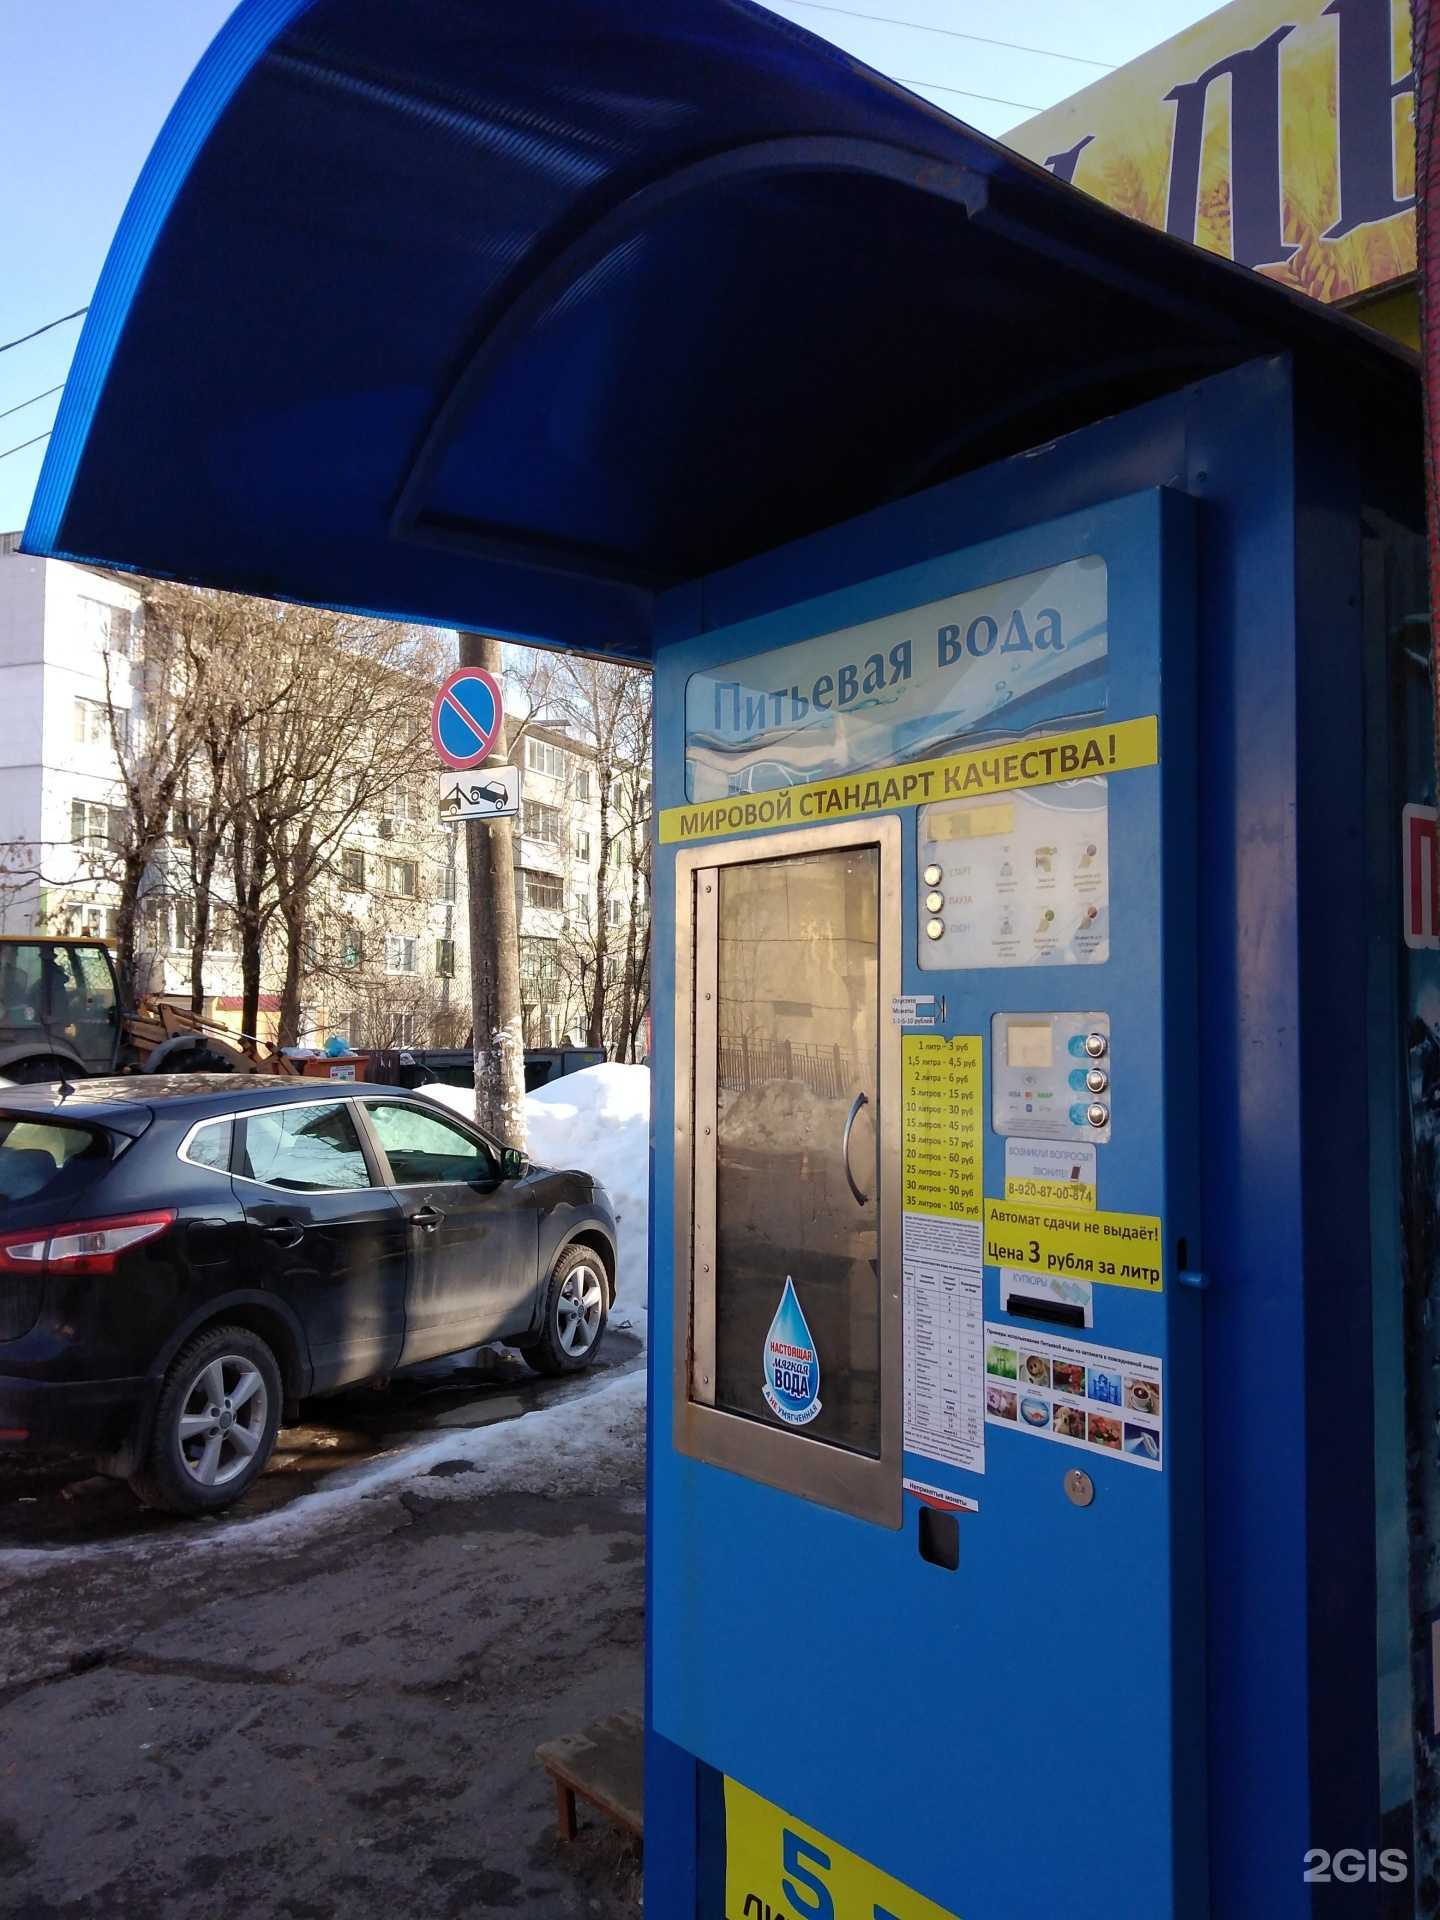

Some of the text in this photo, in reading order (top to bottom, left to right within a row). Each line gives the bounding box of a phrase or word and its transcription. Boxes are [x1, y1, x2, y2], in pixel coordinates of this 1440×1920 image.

[714, 639, 912, 732] Питьевая
[680, 734, 1117, 837] МИРОВОЙ СТАНДАРТ КАЧЕСТВА!
[919, 1041, 923, 1050] 1
[949, 1041, 954, 1051] 3
[908, 1056, 920, 1066] 1,5
[949, 1057, 961, 1068] 4,5
[914, 1072, 920, 1081] 2
[949, 1073, 954, 1082] 6
[911, 1087, 916, 1096] 5
[949, 1089, 959, 1099] 15
[906, 1102, 916, 1112] 10
[949, 1105, 959, 1114] 30
[906, 1118, 916, 1127] 15
[949, 1121, 959, 1130] 45
[906, 1133, 916, 1143] 19
[949, 1137, 959, 1146] 57
[906, 1149, 916, 1158] 20
[949, 1153, 959, 1163] 60
[906, 1165, 916, 1174] 25
[949, 1169, 959, 1179] 75
[906, 1180, 916, 1190] 30
[949, 1185, 959, 1195] 90
[906, 1196, 916, 1206] 35
[949, 1201, 964, 1212] 105
[991, 1208, 1159, 1242] Автомат сдачи не выдаёт!
[988, 1240, 1160, 1285] Цена 3 рубля за литр
[770, 1341, 812, 1361] НАСТОЯЩАЯ
[775, 1369, 809, 1397] ВОДА
